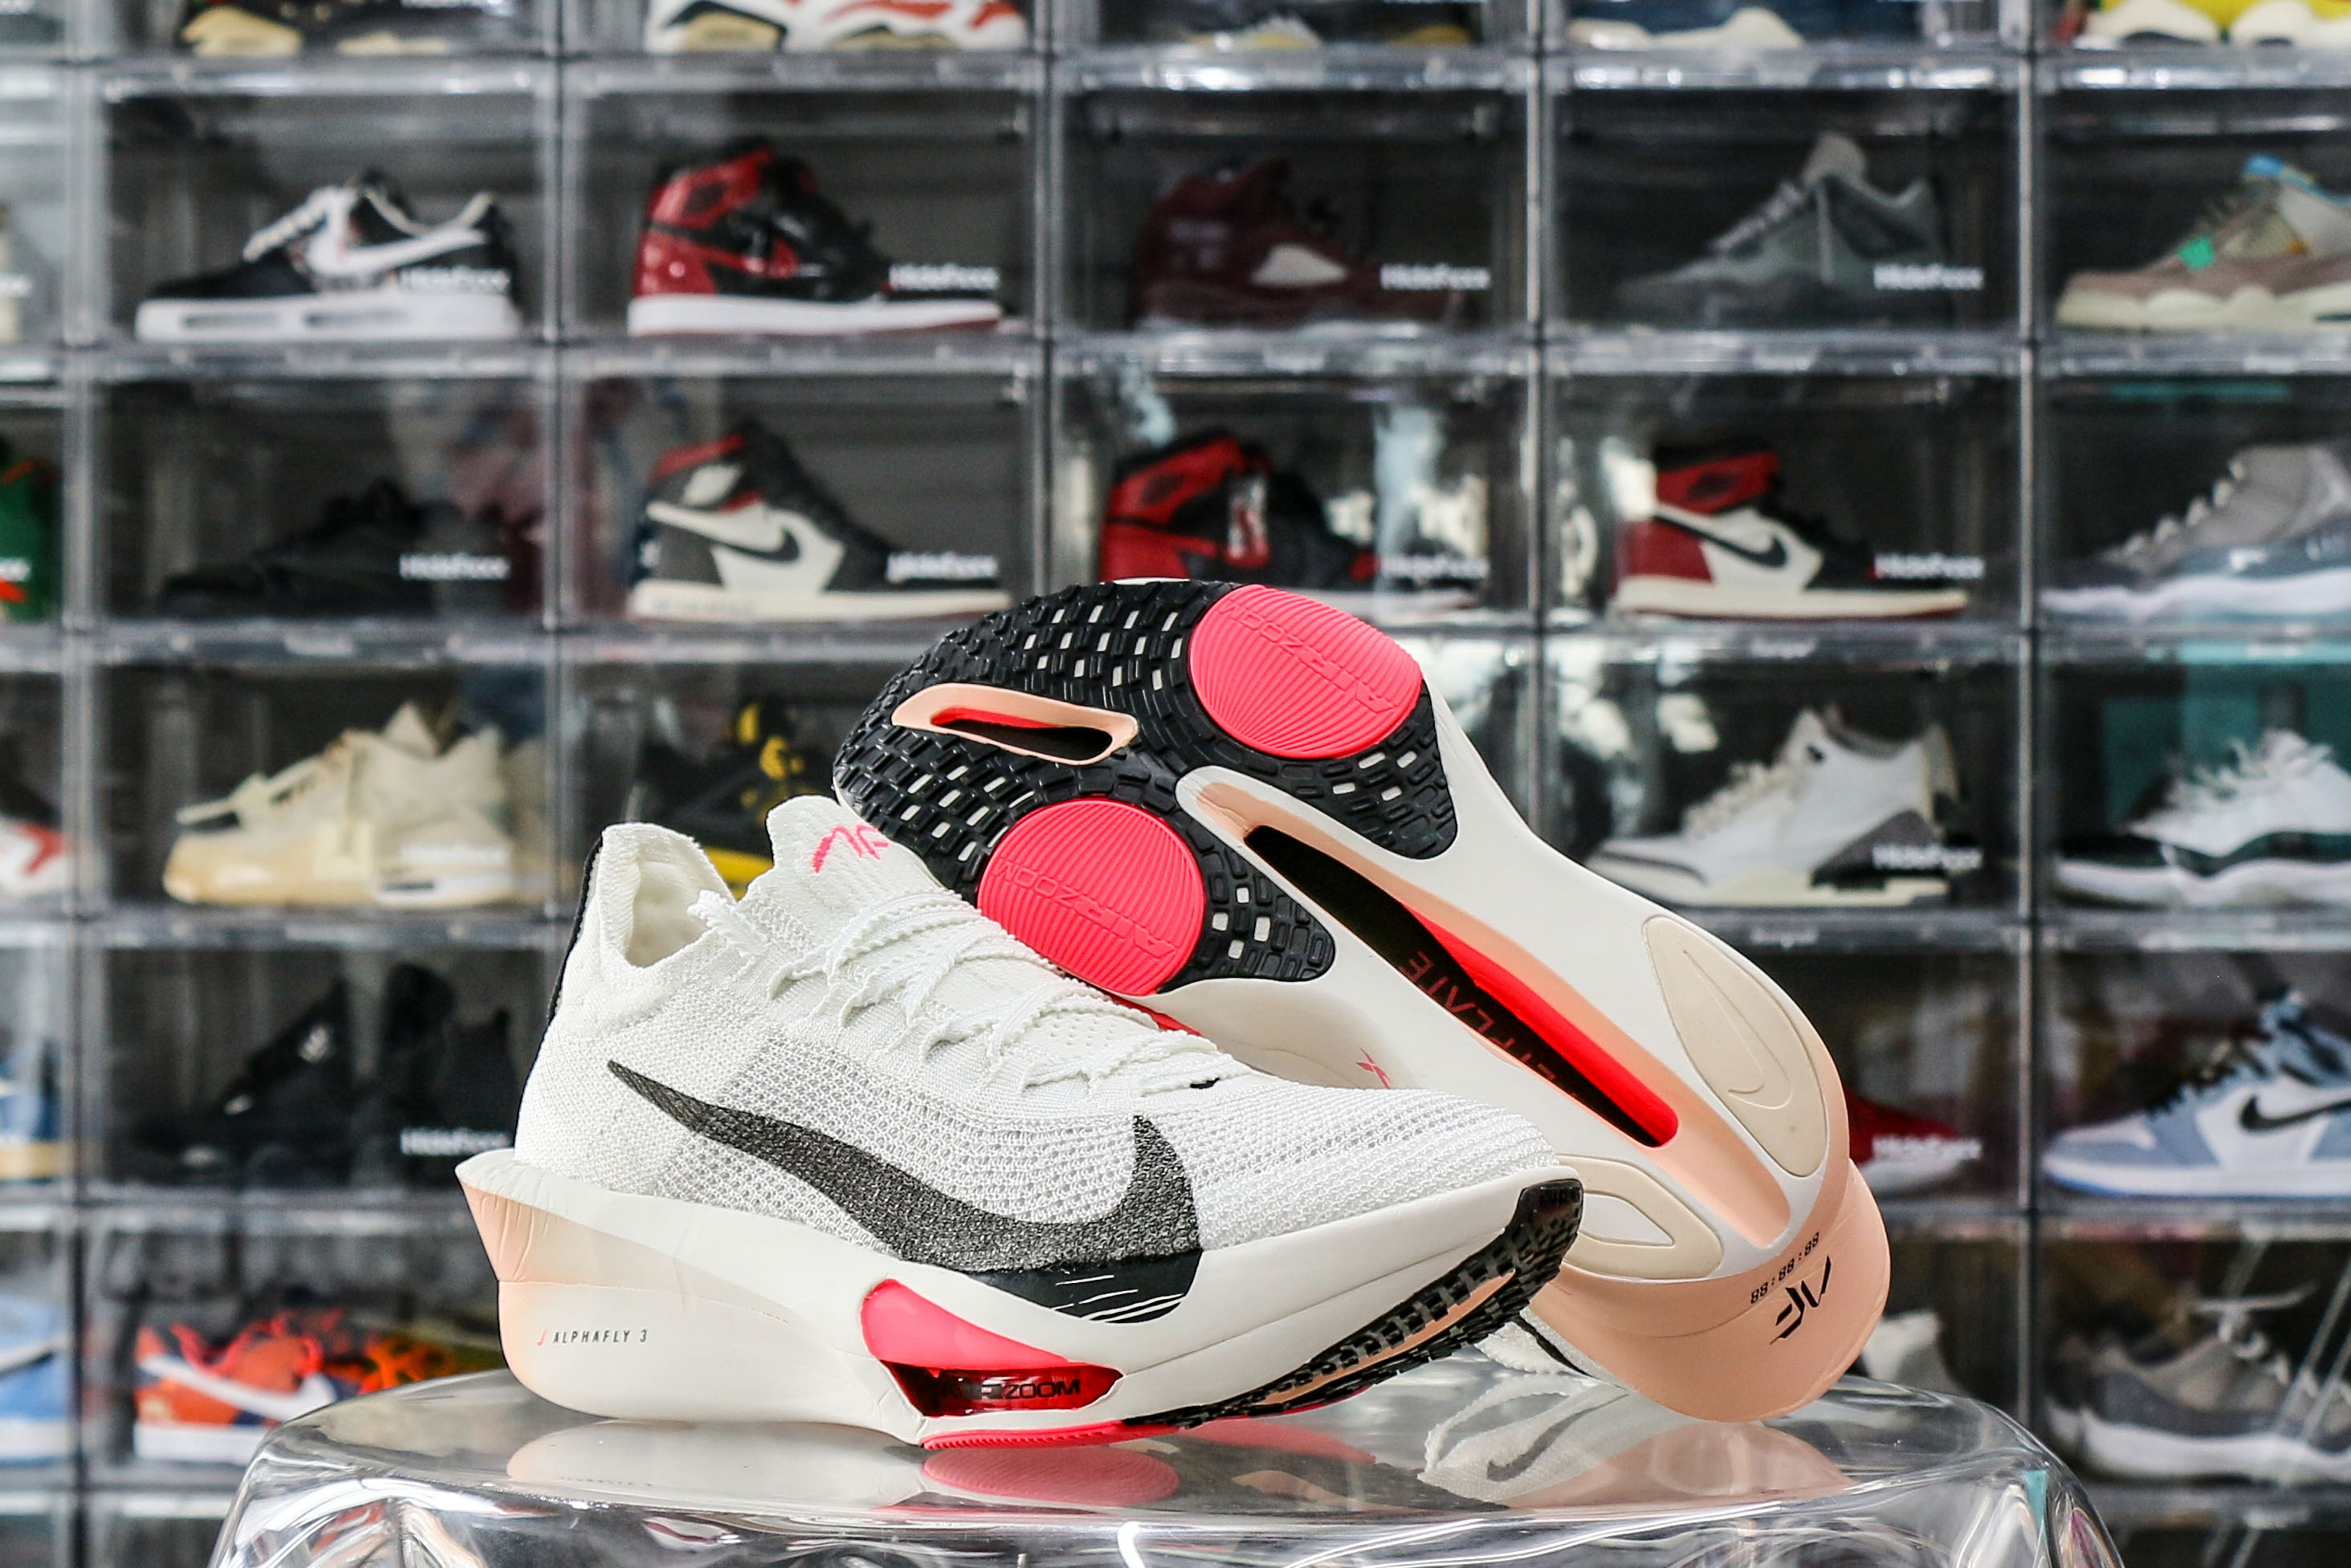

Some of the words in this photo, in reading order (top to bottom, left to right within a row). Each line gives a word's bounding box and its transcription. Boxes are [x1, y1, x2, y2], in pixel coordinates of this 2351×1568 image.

[1216, 597, 1398, 714] AIRZOOM
[989, 857, 1179, 958] AIRZOOM
[553, 1330, 630, 1344] ALPHAFLY
[639, 1330, 648, 1343] 3
